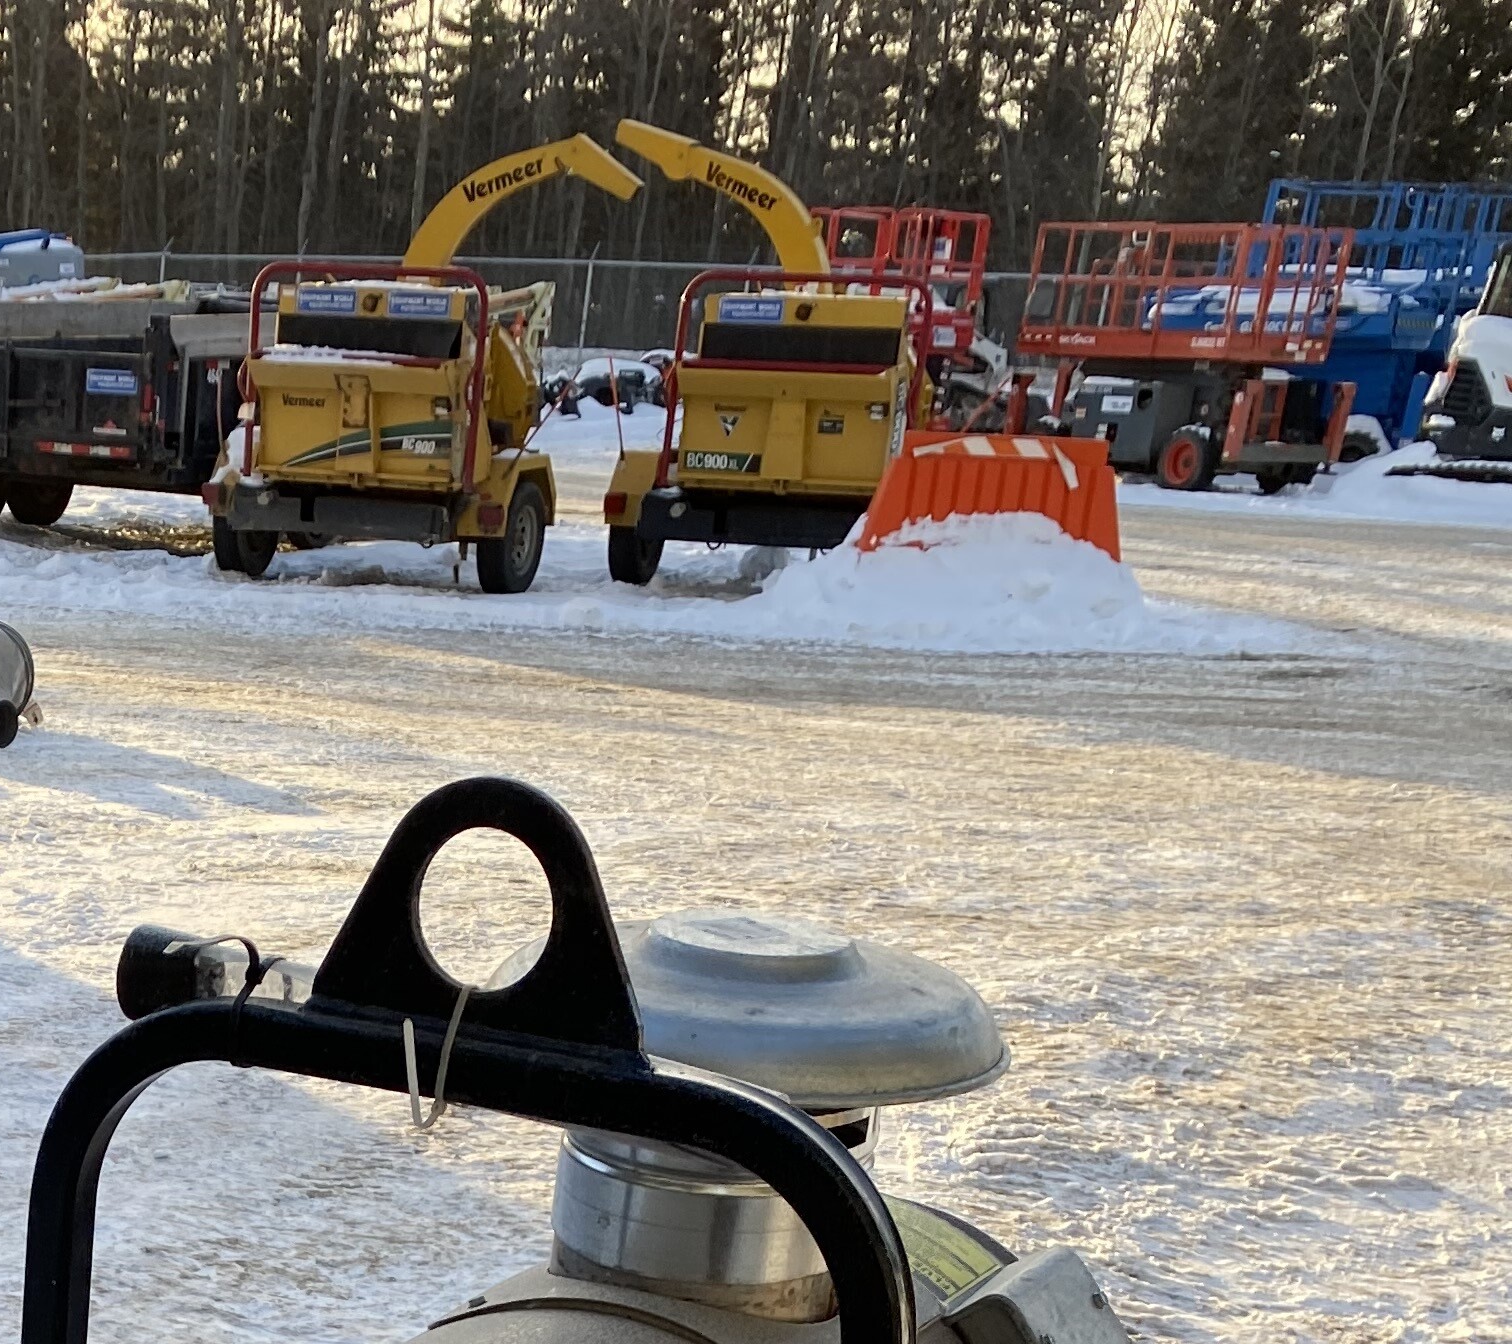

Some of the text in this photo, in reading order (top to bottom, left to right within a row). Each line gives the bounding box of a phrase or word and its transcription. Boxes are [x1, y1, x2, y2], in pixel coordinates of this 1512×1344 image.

[462, 156, 544, 203] Vermeer
[706, 160, 778, 211] Vermeer
[281, 393, 326, 407] Vermeer
